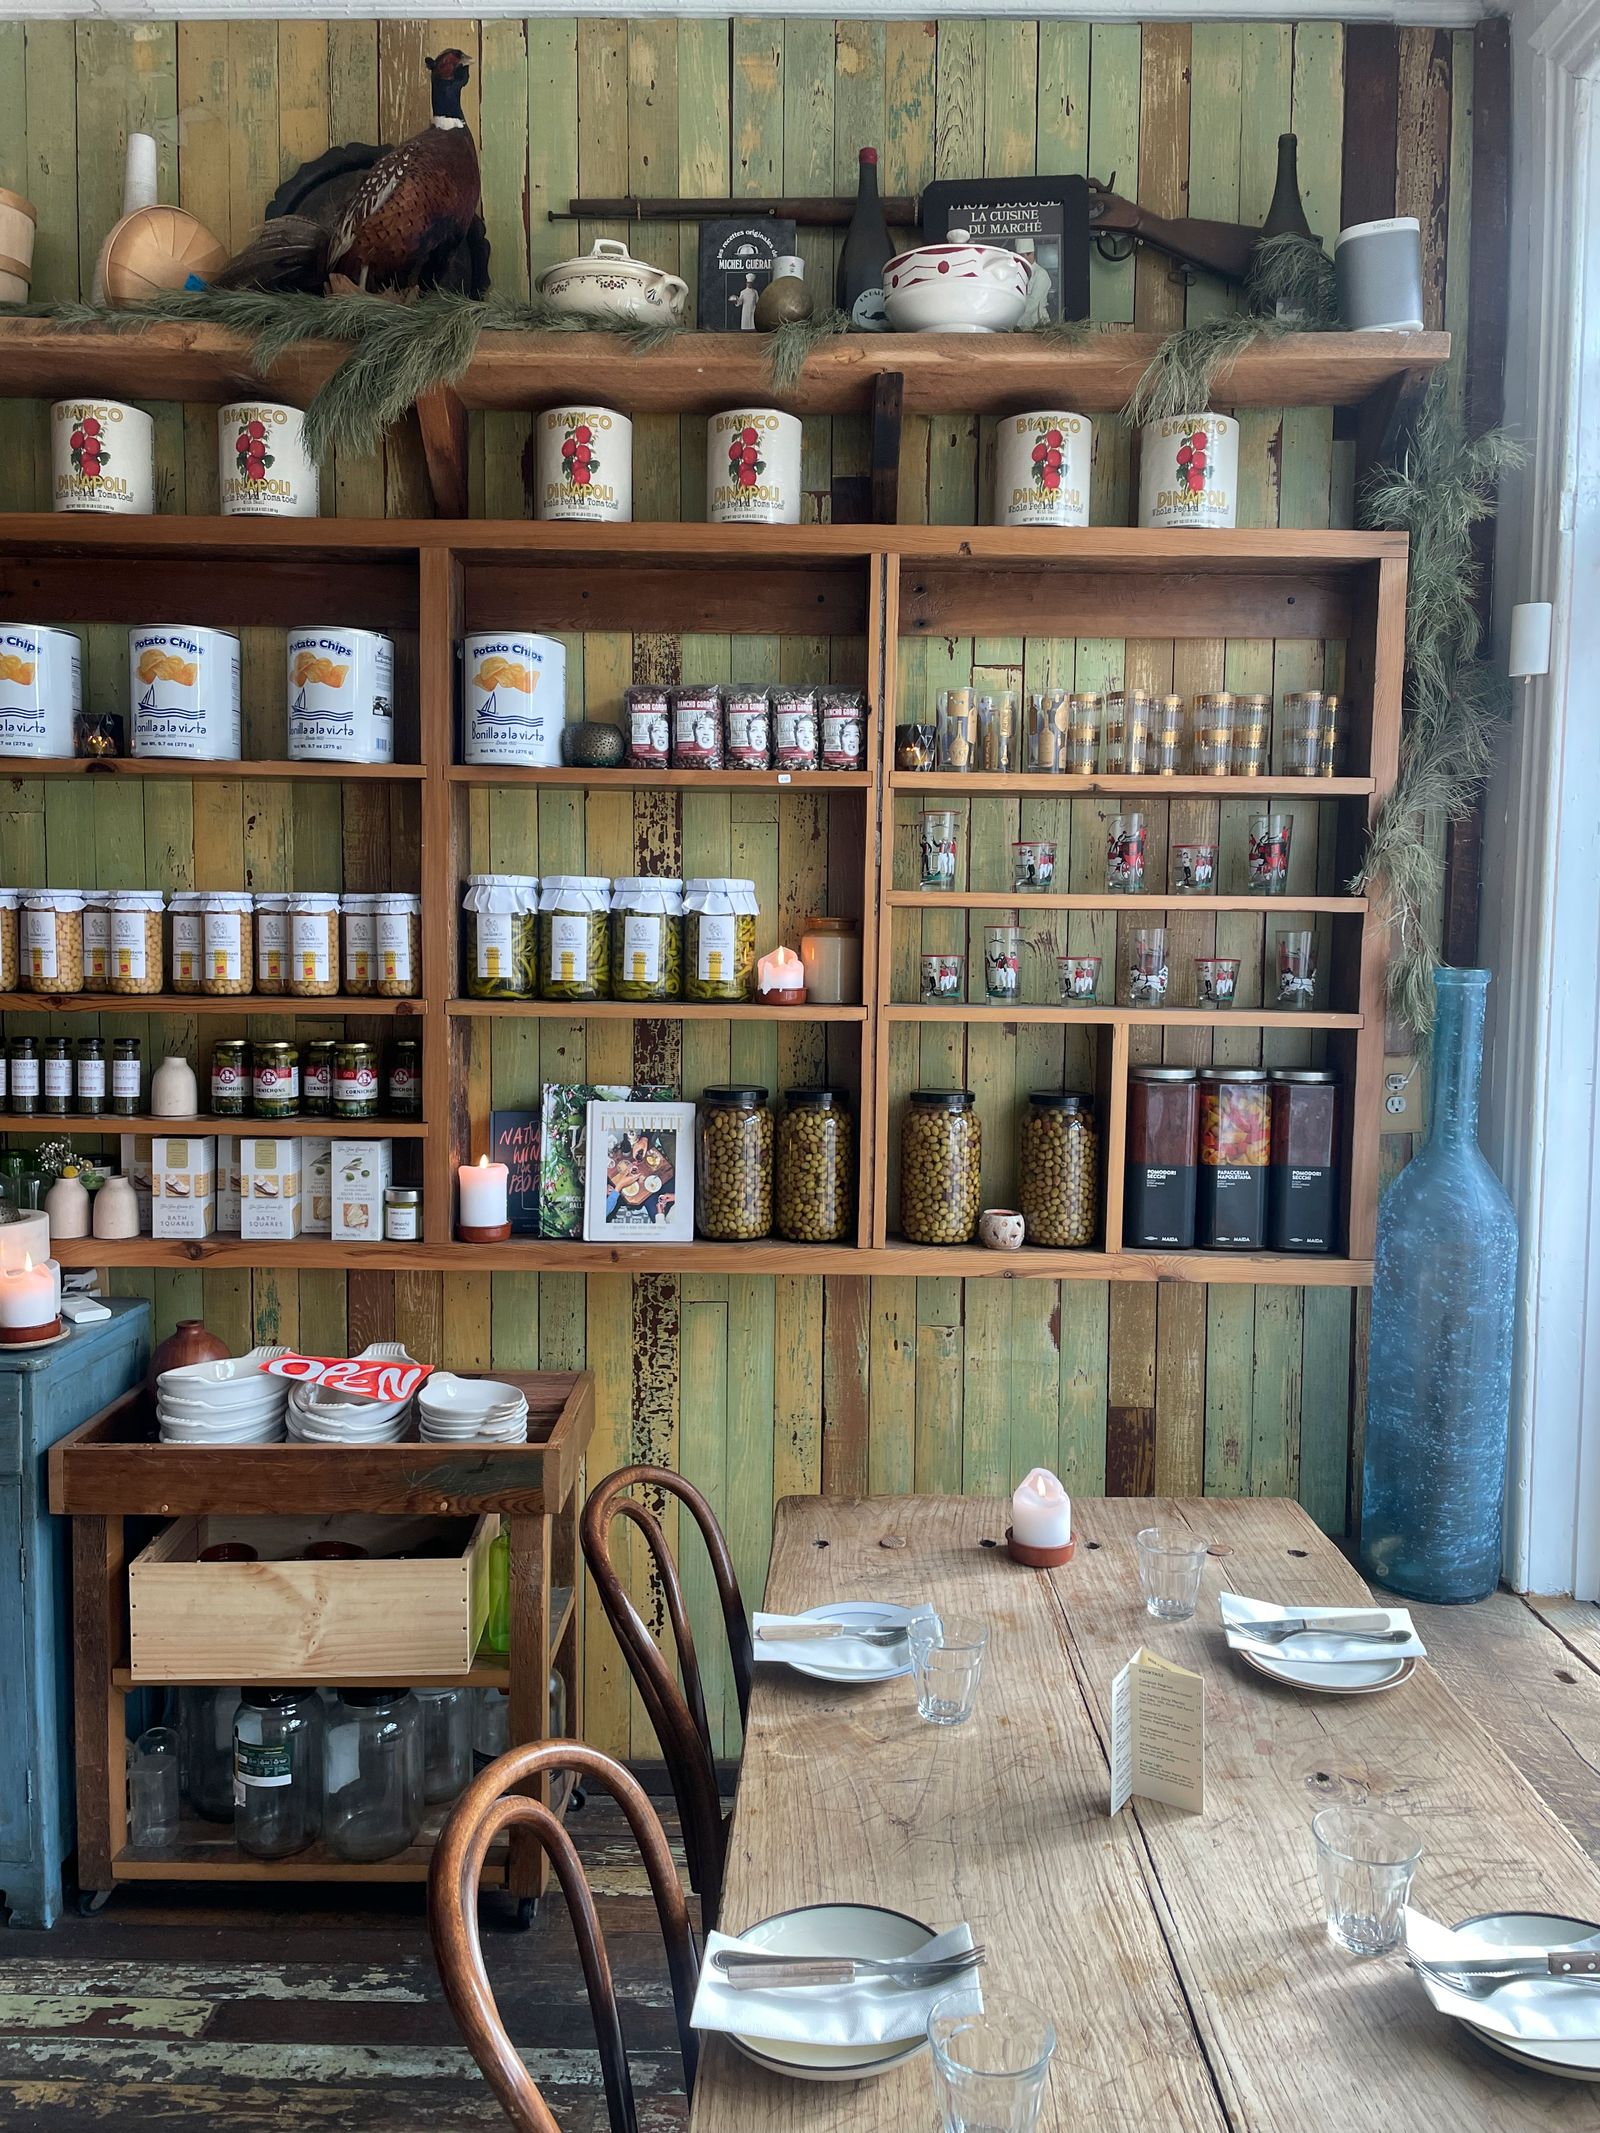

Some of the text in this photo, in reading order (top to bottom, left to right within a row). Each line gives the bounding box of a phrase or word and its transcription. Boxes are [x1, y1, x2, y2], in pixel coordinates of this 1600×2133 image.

[971, 210, 1039, 222] LA CUISINE
[968, 220, 1042, 234] DU MARCHÉ
[722, 230, 744, 248] recettes
[745, 229, 774, 249] originales
[718, 259, 745, 270] MICHEL
[57, 404, 123, 422] BIANCO
[223, 408, 288, 425] BIANCO
[548, 412, 612, 430] BIANCO
[716, 414, 779, 433] BIANCO
[1016, 416, 1080, 434] BIANCO
[1152, 506, 1171, 516] Whole
[7, 636, 42, 654] Chips
[135, 637, 204, 654] Potato Chips
[319, 640, 352, 656] Chips
[473, 644, 542, 662] Potato Chips
[5, 719, 14, 732] la
[167, 720, 176, 731] la
[316, 722, 324, 734] la
[472, 720, 499, 740] Bonilla
[509, 727, 517, 739] la
[601, 1116, 616, 1132] LA
[500, 1124, 540, 1145] NATU
[513, 1145, 540, 1164] WIN
[508, 1174, 540, 1195] PEOP
[268, 1358, 422, 1400] OPEN
